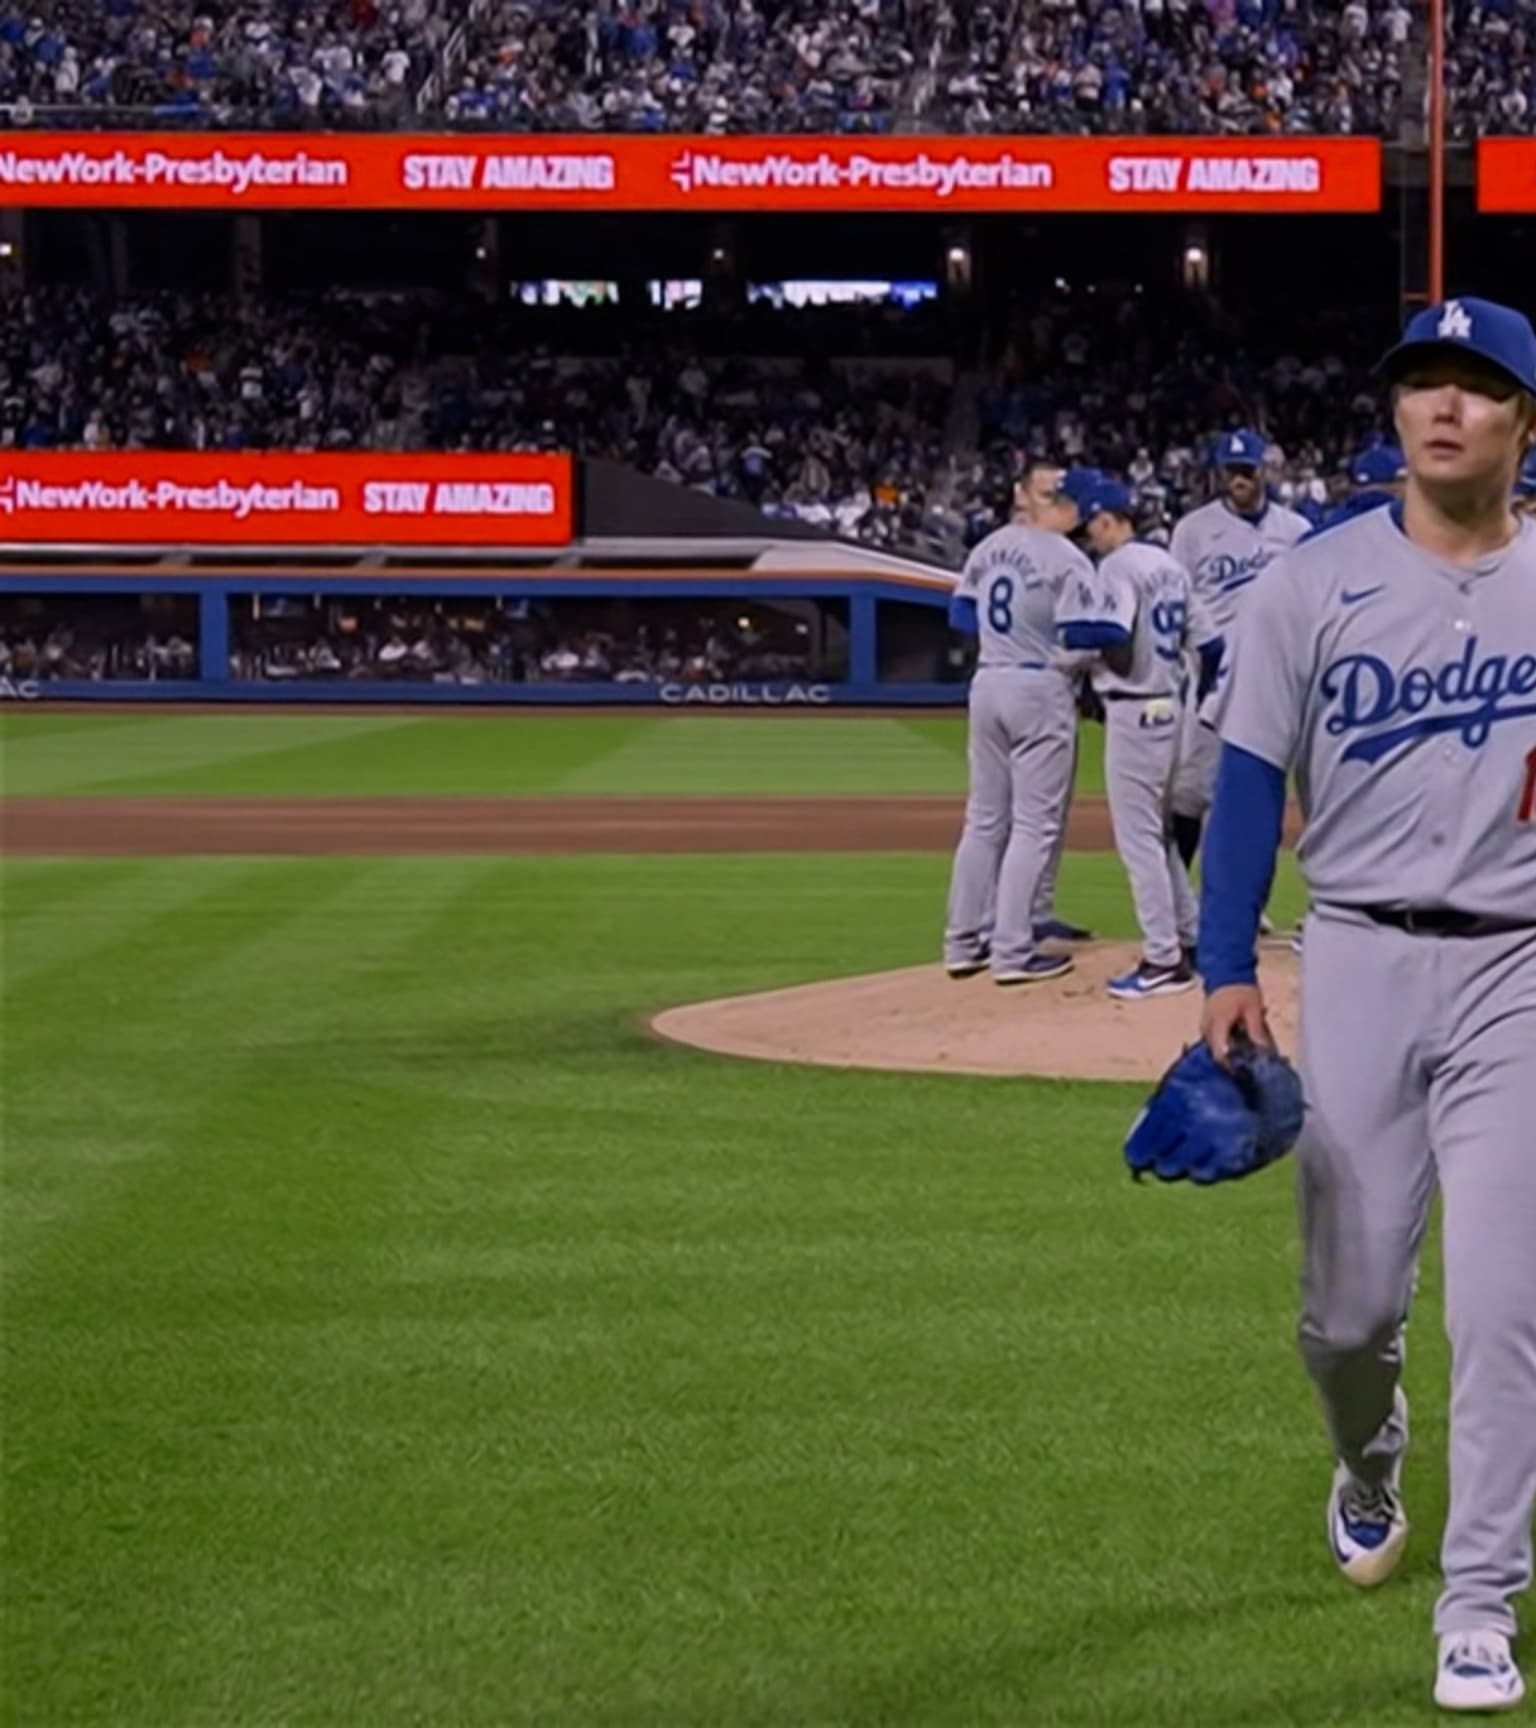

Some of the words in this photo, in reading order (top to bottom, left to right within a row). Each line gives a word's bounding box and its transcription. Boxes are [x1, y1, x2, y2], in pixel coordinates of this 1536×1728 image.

[0, 152, 346, 193] NewYork-Presbyterian
[404, 156, 476, 189] STAY
[482, 156, 614, 189] AMAZING
[694, 155, 1051, 196] NewYork-Presbyterian
[1109, 158, 1182, 191] STAY
[1187, 158, 1319, 191] AMAZING
[1438, 299, 1472, 339] LA
[16, 480, 339, 518] NewYork-Presbyterian
[364, 482, 429, 512] STAY
[434, 483, 554, 513] AMAZING
[988, 576, 1013, 634] 8
[659, 684, 831, 703] CADILLAC
